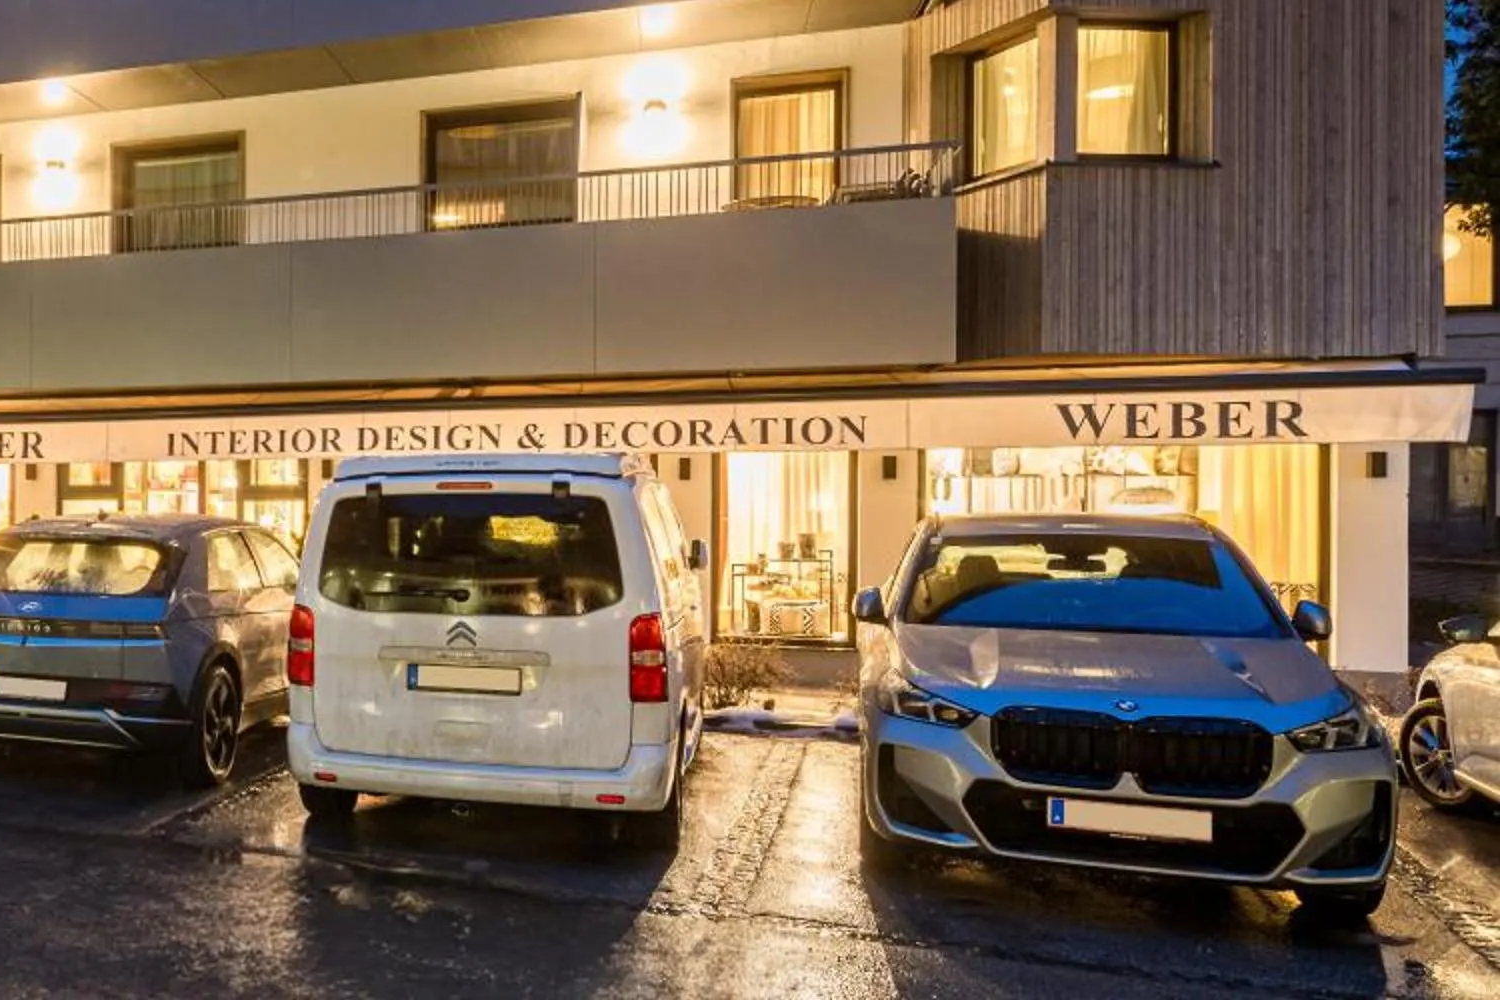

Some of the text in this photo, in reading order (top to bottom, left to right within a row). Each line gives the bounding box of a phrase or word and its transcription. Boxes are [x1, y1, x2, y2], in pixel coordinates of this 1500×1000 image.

[167, 415, 868, 457] INTERIOR DESIGN & DECORATION
[1055, 399, 1308, 440] WEBER
